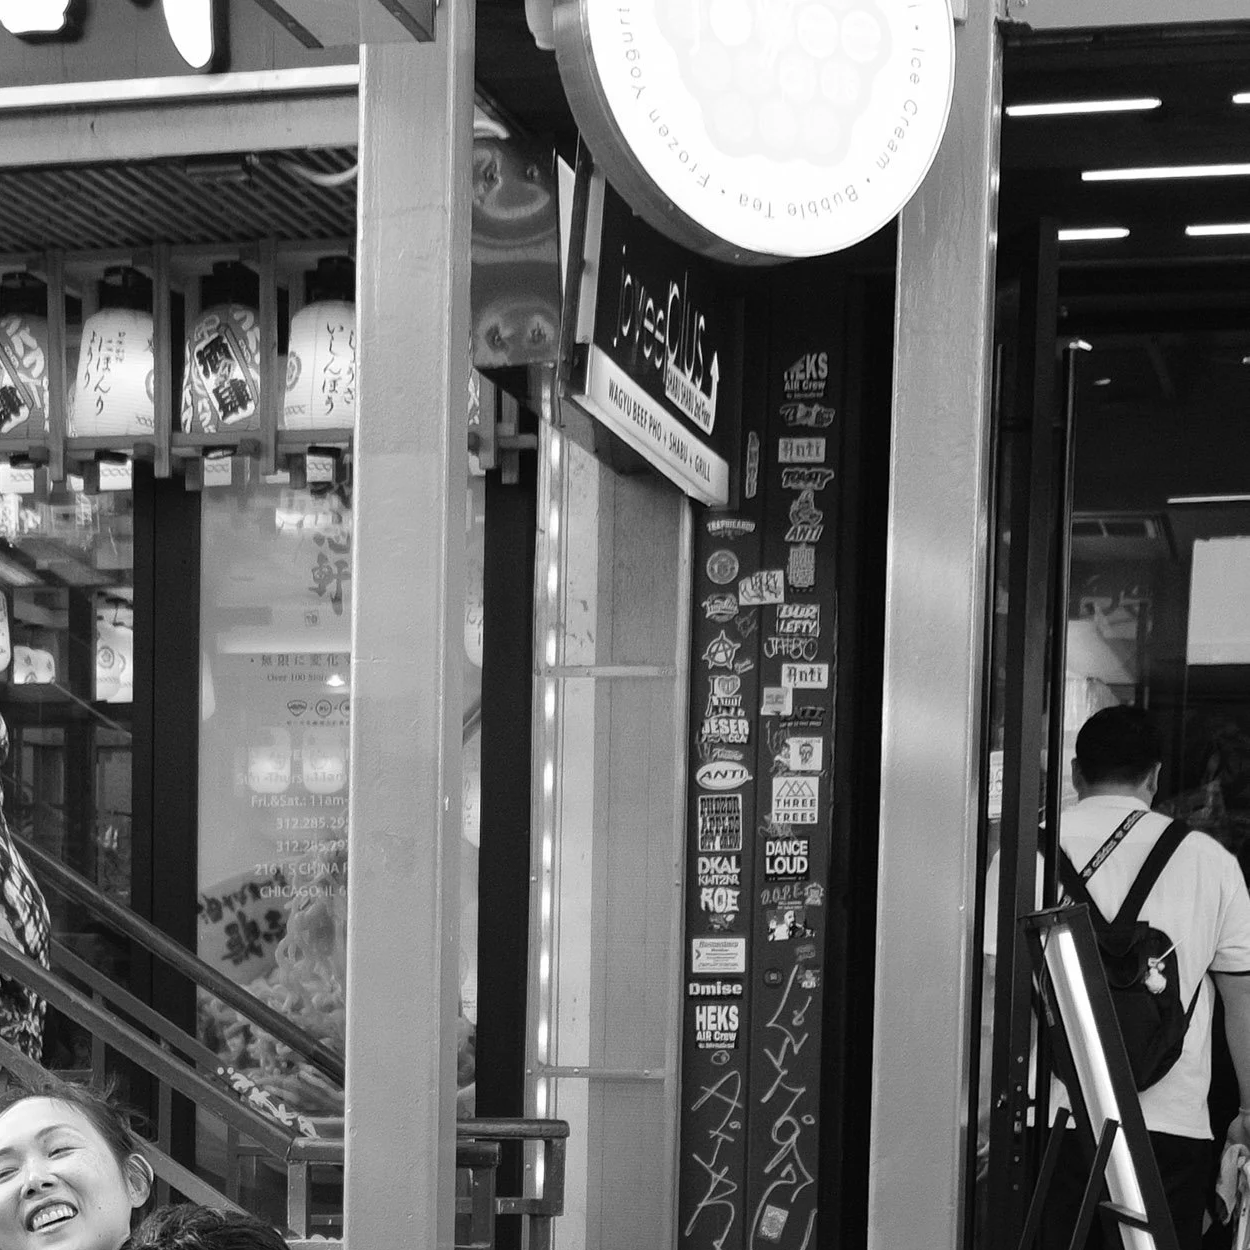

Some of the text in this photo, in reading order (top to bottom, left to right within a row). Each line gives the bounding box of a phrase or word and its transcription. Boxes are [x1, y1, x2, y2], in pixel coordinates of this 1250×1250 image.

[875, 47, 925, 170] Ice Cream
[648, 108, 711, 188] Frozen
[739, 184, 859, 219] Bubble Tea
[608, 378, 632, 417] WAGYU
[632, 405, 649, 432] BEEF
[649, 412, 662, 443] PHO
[669, 432, 688, 464] SHABU
[695, 454, 711, 483] GRILL
[701, 769, 744, 780] ANTI
[774, 798, 817, 808] THREE
[774, 812, 816, 822] TREES
[765, 840, 808, 856] DANCE
[765, 856, 808, 874] LOUD
[695, 1005, 739, 1031] HEKS
[695, 1031, 737, 1042] AIR Crew
